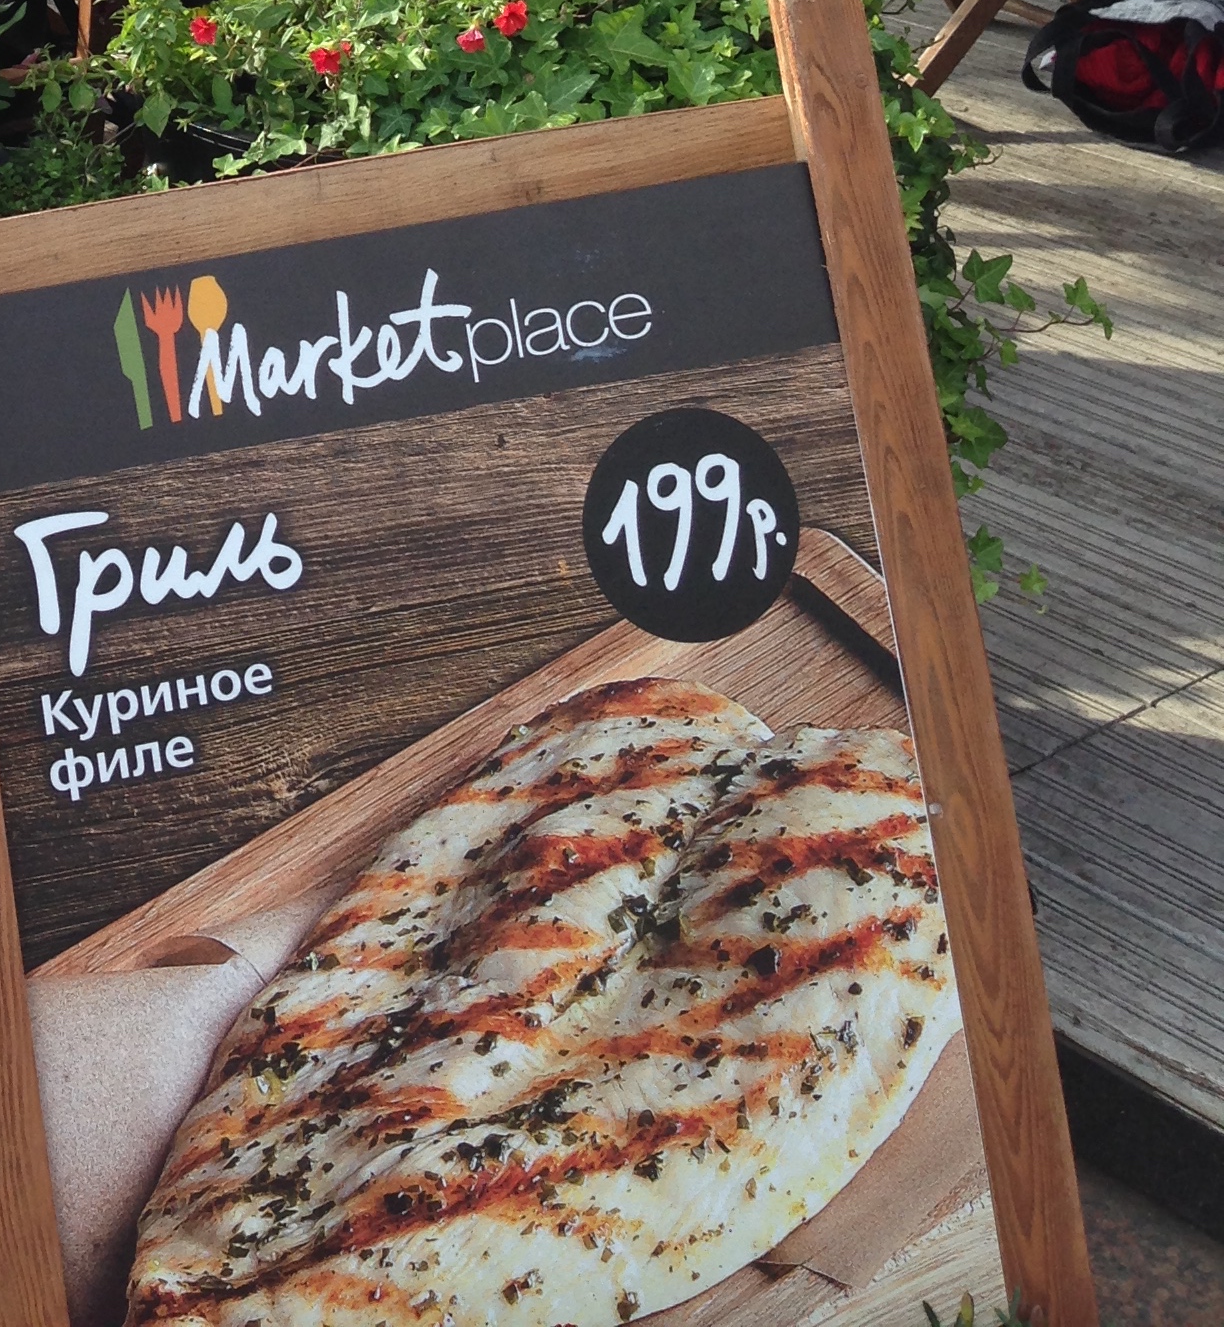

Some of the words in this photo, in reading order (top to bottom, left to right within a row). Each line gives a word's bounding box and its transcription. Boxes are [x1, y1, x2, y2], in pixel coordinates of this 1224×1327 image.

[13, 510, 304, 678] Гриль
[40, 662, 274, 742] Куриное
[48, 735, 195, 802] филе
